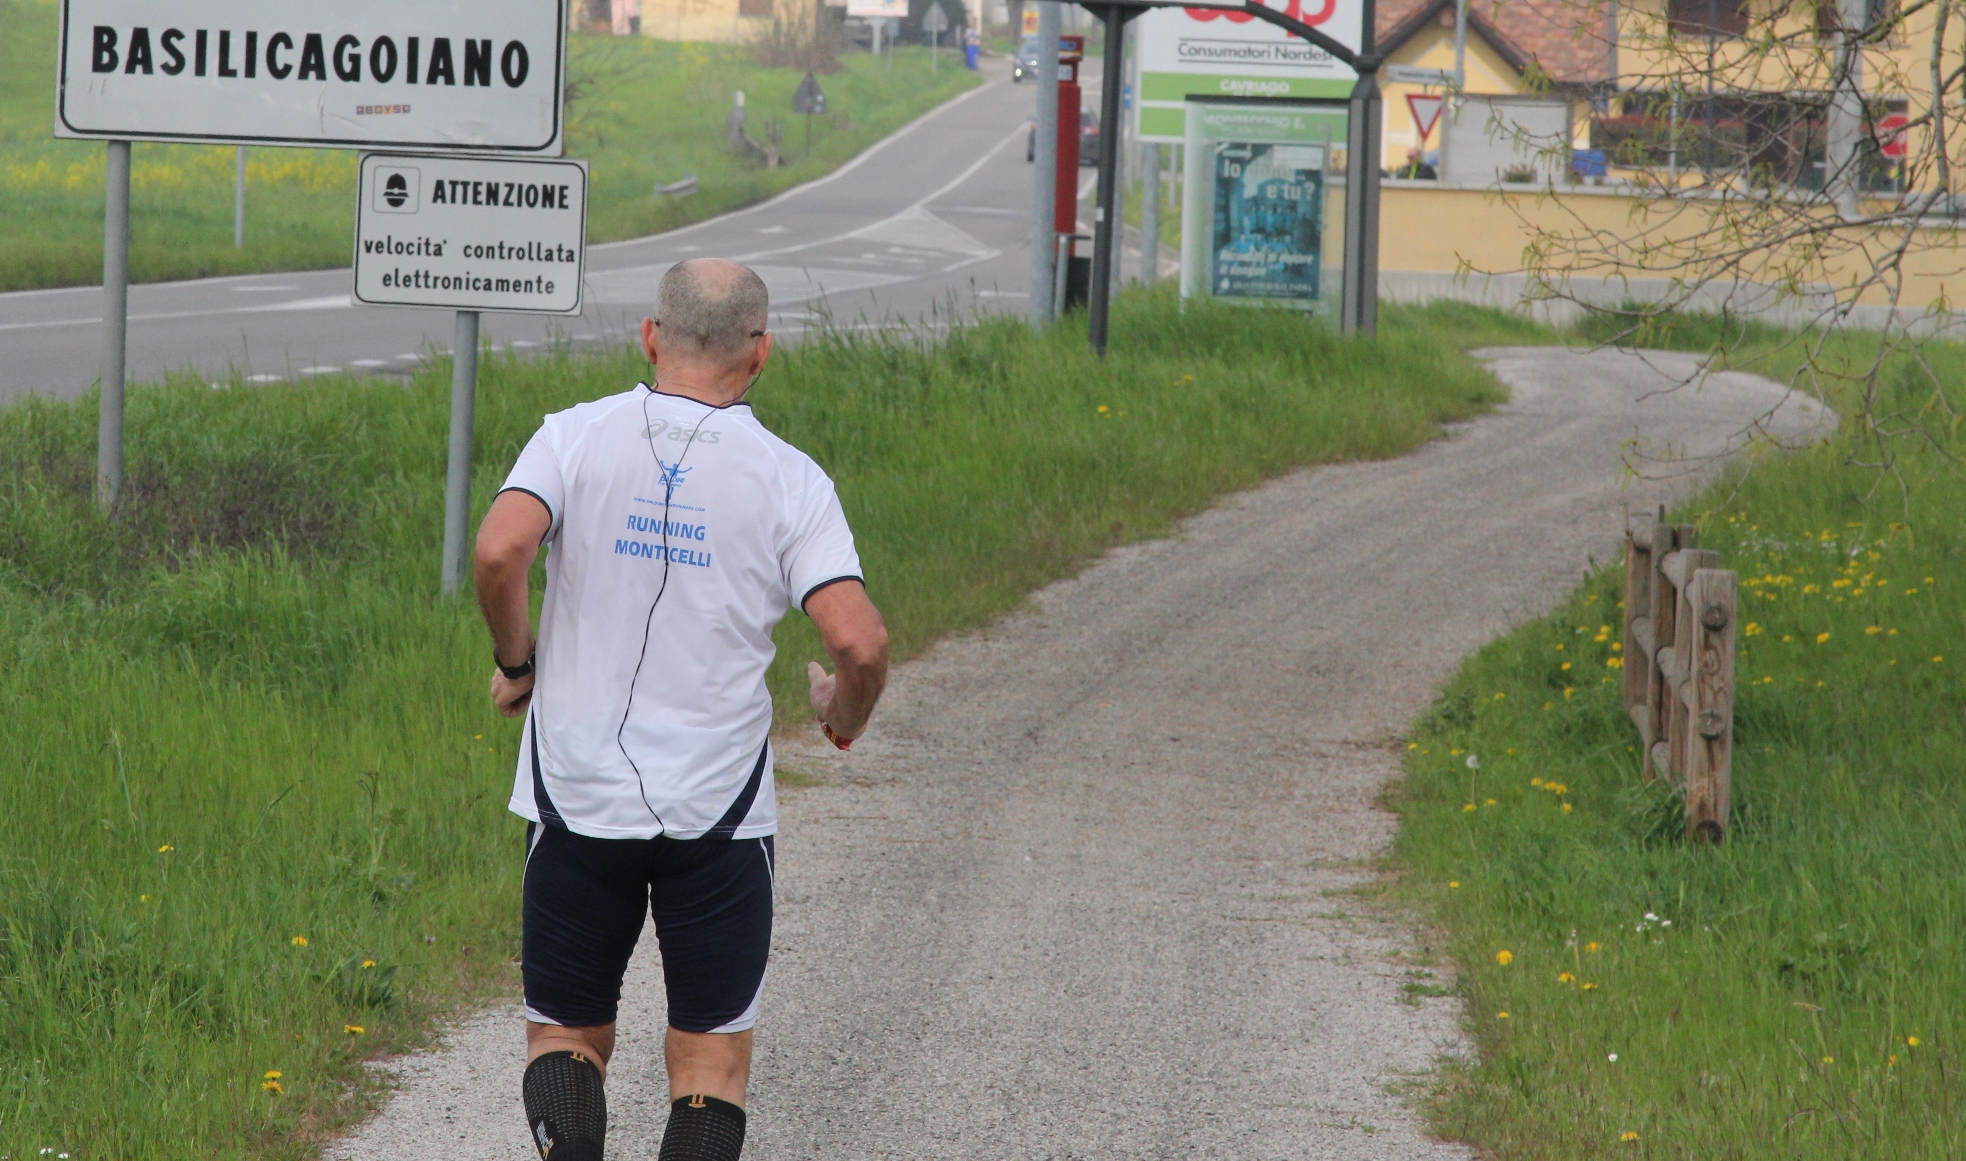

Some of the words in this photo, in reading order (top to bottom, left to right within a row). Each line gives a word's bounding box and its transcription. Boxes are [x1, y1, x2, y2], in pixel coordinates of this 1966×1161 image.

[91, 25, 530, 88] BASILICAGOIANO
[1178, 43, 1271, 60] Consumatori
[432, 179, 569, 210] ATTENZIONE
[463, 241, 576, 263] controllata
[382, 268, 555, 294] elettronicamente
[627, 514, 706, 541] RUNNING
[614, 539, 712, 568] MONTICELLI
